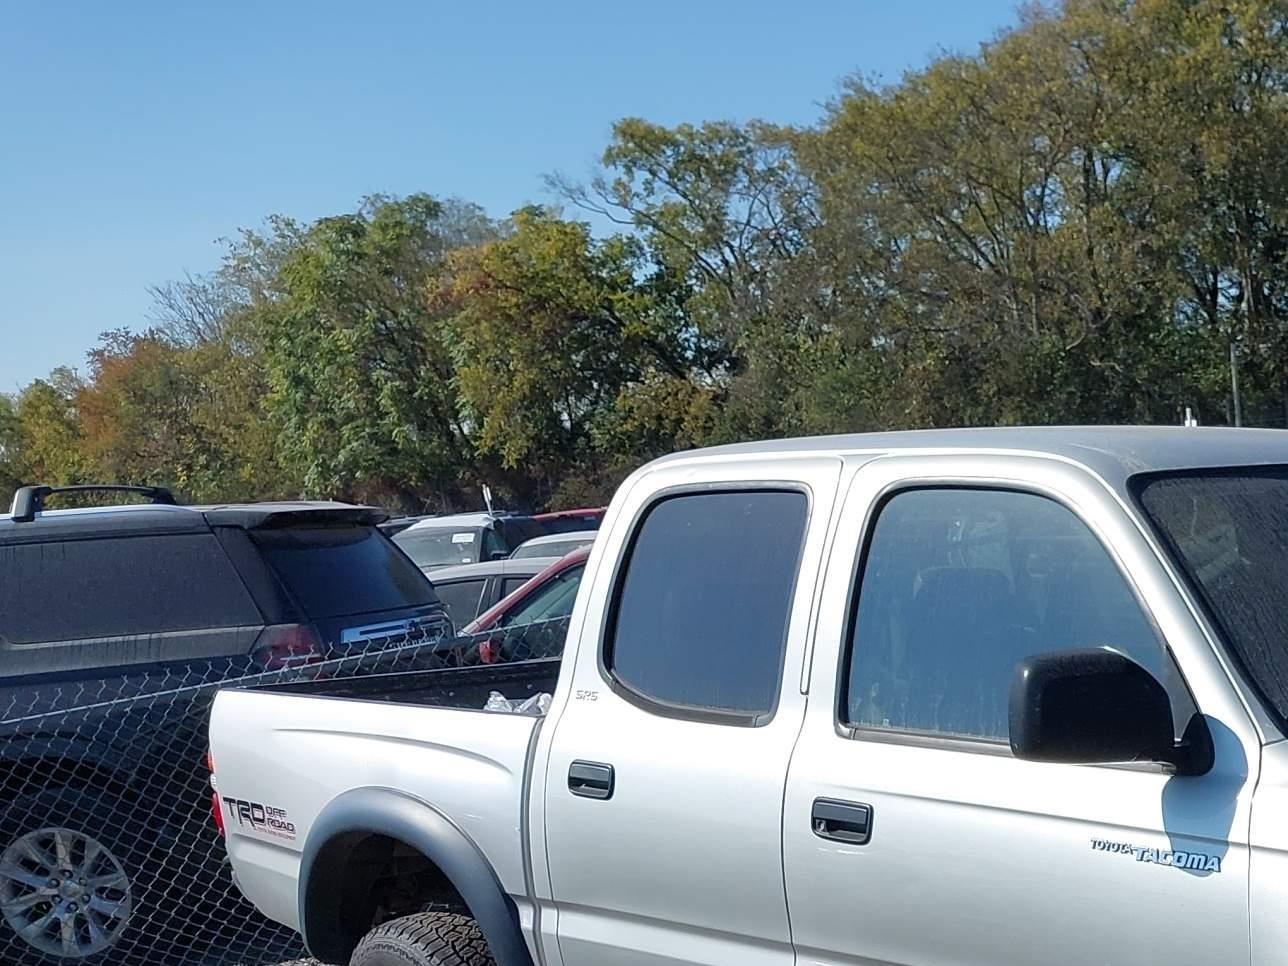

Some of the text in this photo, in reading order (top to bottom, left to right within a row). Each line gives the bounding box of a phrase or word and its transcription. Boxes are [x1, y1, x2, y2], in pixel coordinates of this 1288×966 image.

[222, 796, 265, 829] TRD
[266, 806, 287, 818] OFF
[267, 818, 296, 834] ROAD
[1091, 838, 1221, 872] TOYOTA TACOMA
